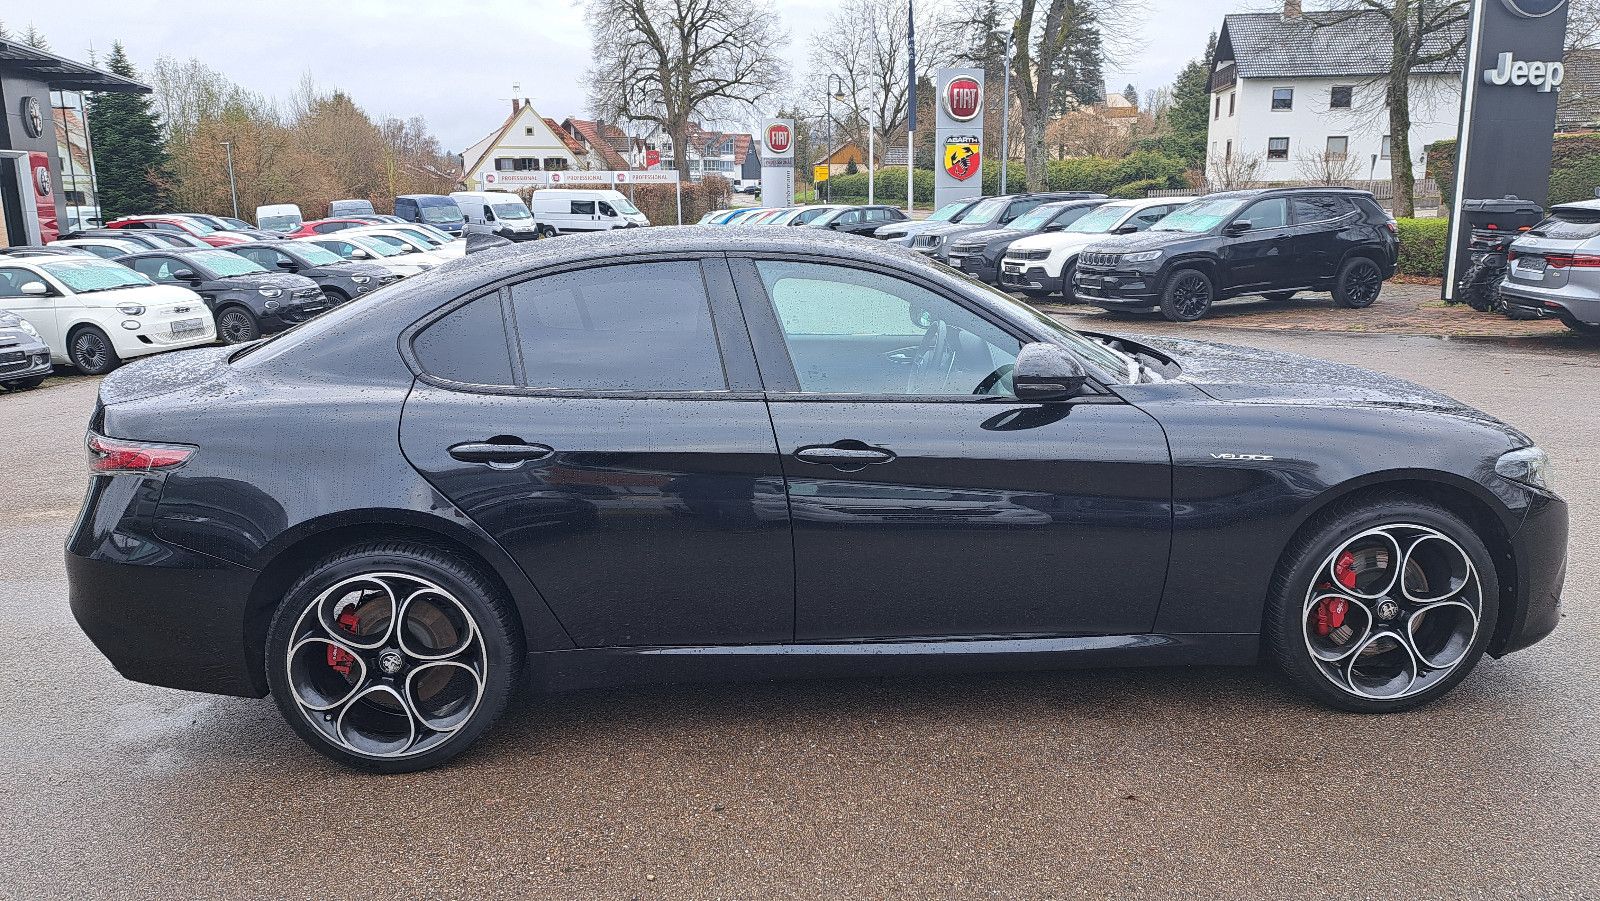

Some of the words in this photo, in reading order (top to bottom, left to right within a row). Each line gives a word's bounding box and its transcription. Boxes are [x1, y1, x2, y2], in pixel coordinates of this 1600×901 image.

[1484, 52, 1564, 92] Jeep
[953, 88, 977, 109] FIAT
[771, 131, 788, 145] FIAT
[1210, 453, 1273, 461] VELOCE
